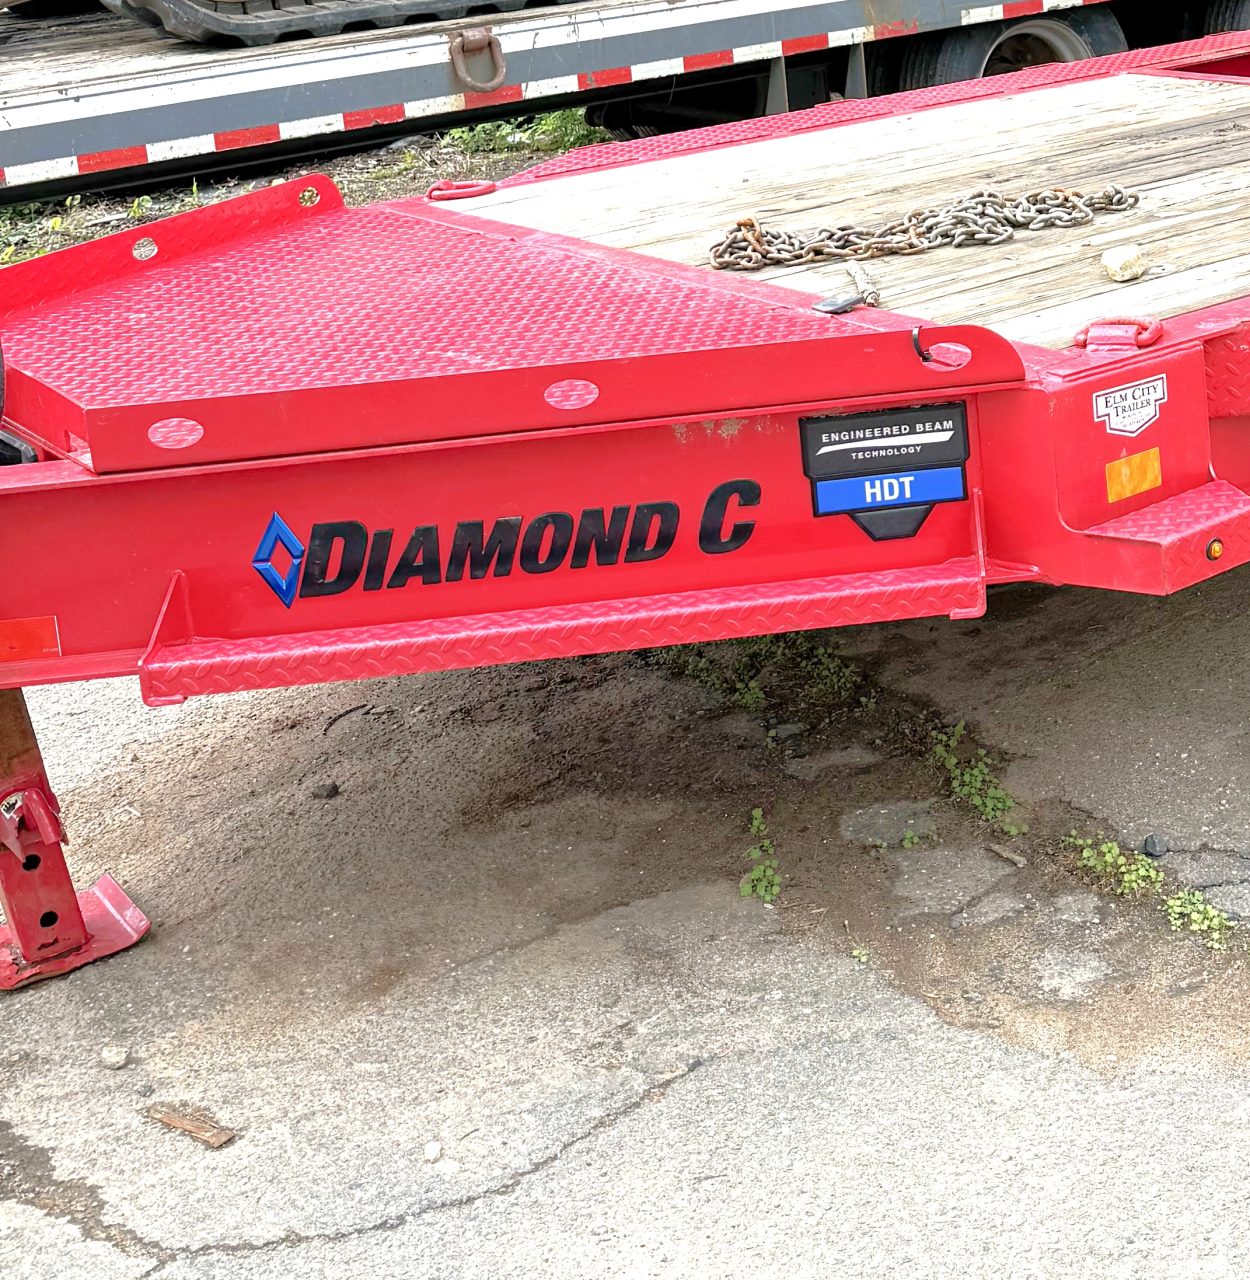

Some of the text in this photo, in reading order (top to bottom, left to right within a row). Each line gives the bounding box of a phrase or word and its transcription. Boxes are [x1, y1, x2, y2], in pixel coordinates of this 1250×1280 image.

[1104, 383, 1159, 409] ELM CITY
[1113, 398, 1151, 417] TRAILER
[821, 420, 954, 443] ENGINEERED BEAM
[851, 445, 922, 460] TECHNOLOGY
[864, 476, 915, 503] HDT
[299, 479, 762, 599] DIAMOND C
